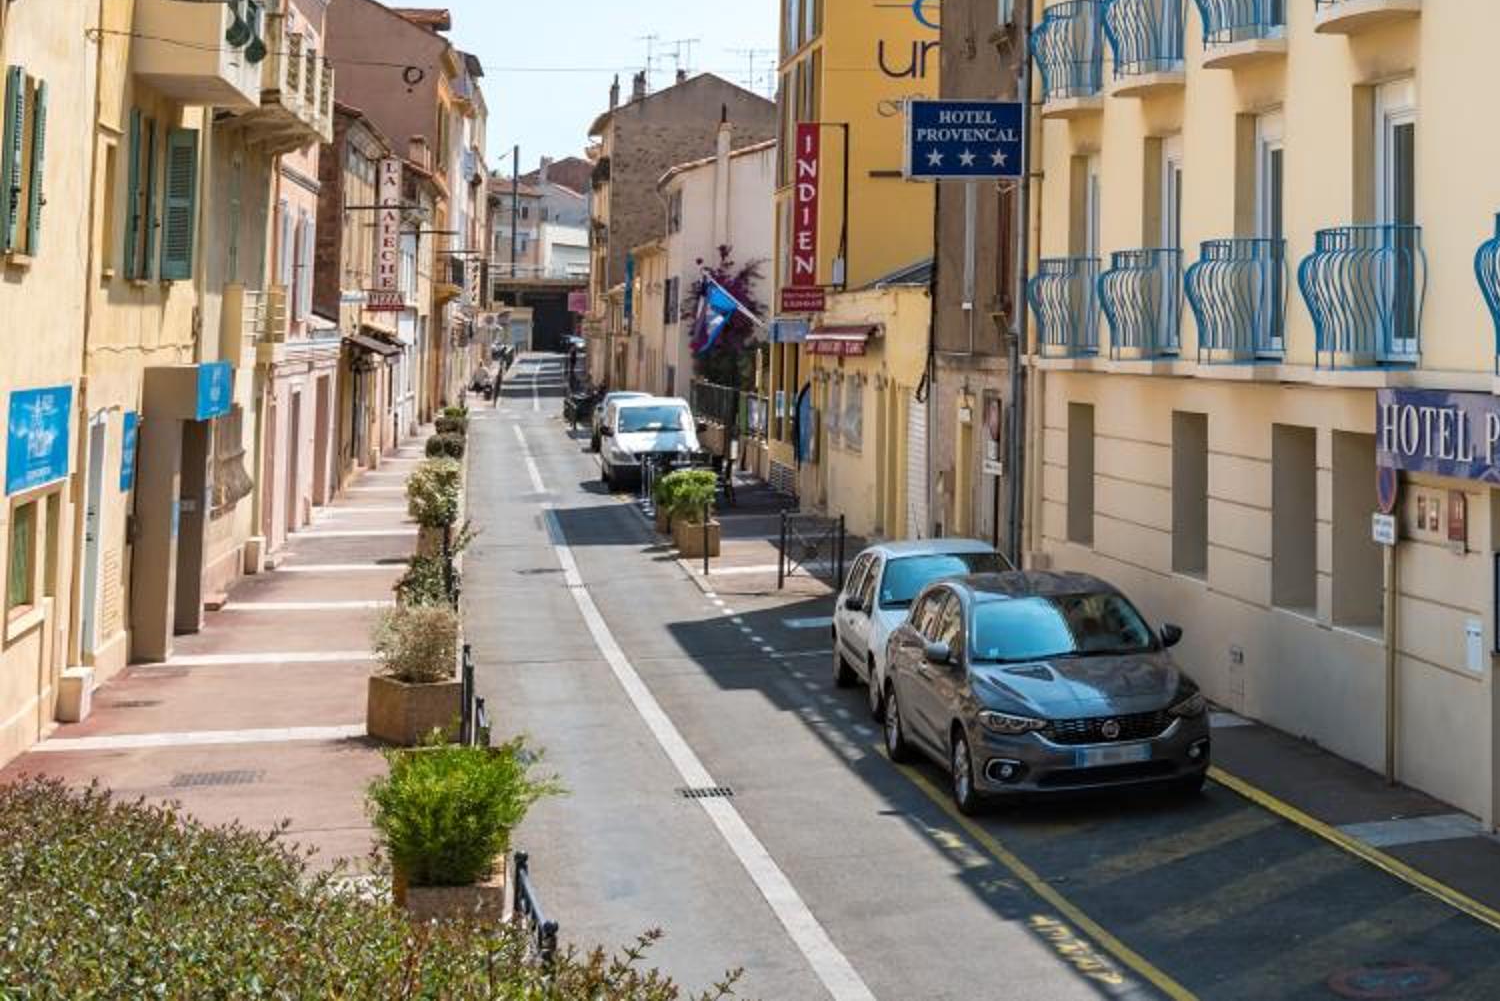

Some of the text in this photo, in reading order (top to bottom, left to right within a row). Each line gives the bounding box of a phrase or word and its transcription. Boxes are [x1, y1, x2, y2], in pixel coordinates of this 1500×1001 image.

[916, 128, 1019, 142] PROVENCAL
[939, 110, 997, 124] HOTEL
[795, 134, 818, 275] INDIEN
[381, 162, 396, 288] LA CALECHE
[369, 293, 404, 304] PIZZA
[1381, 404, 1473, 463] HOTEL
